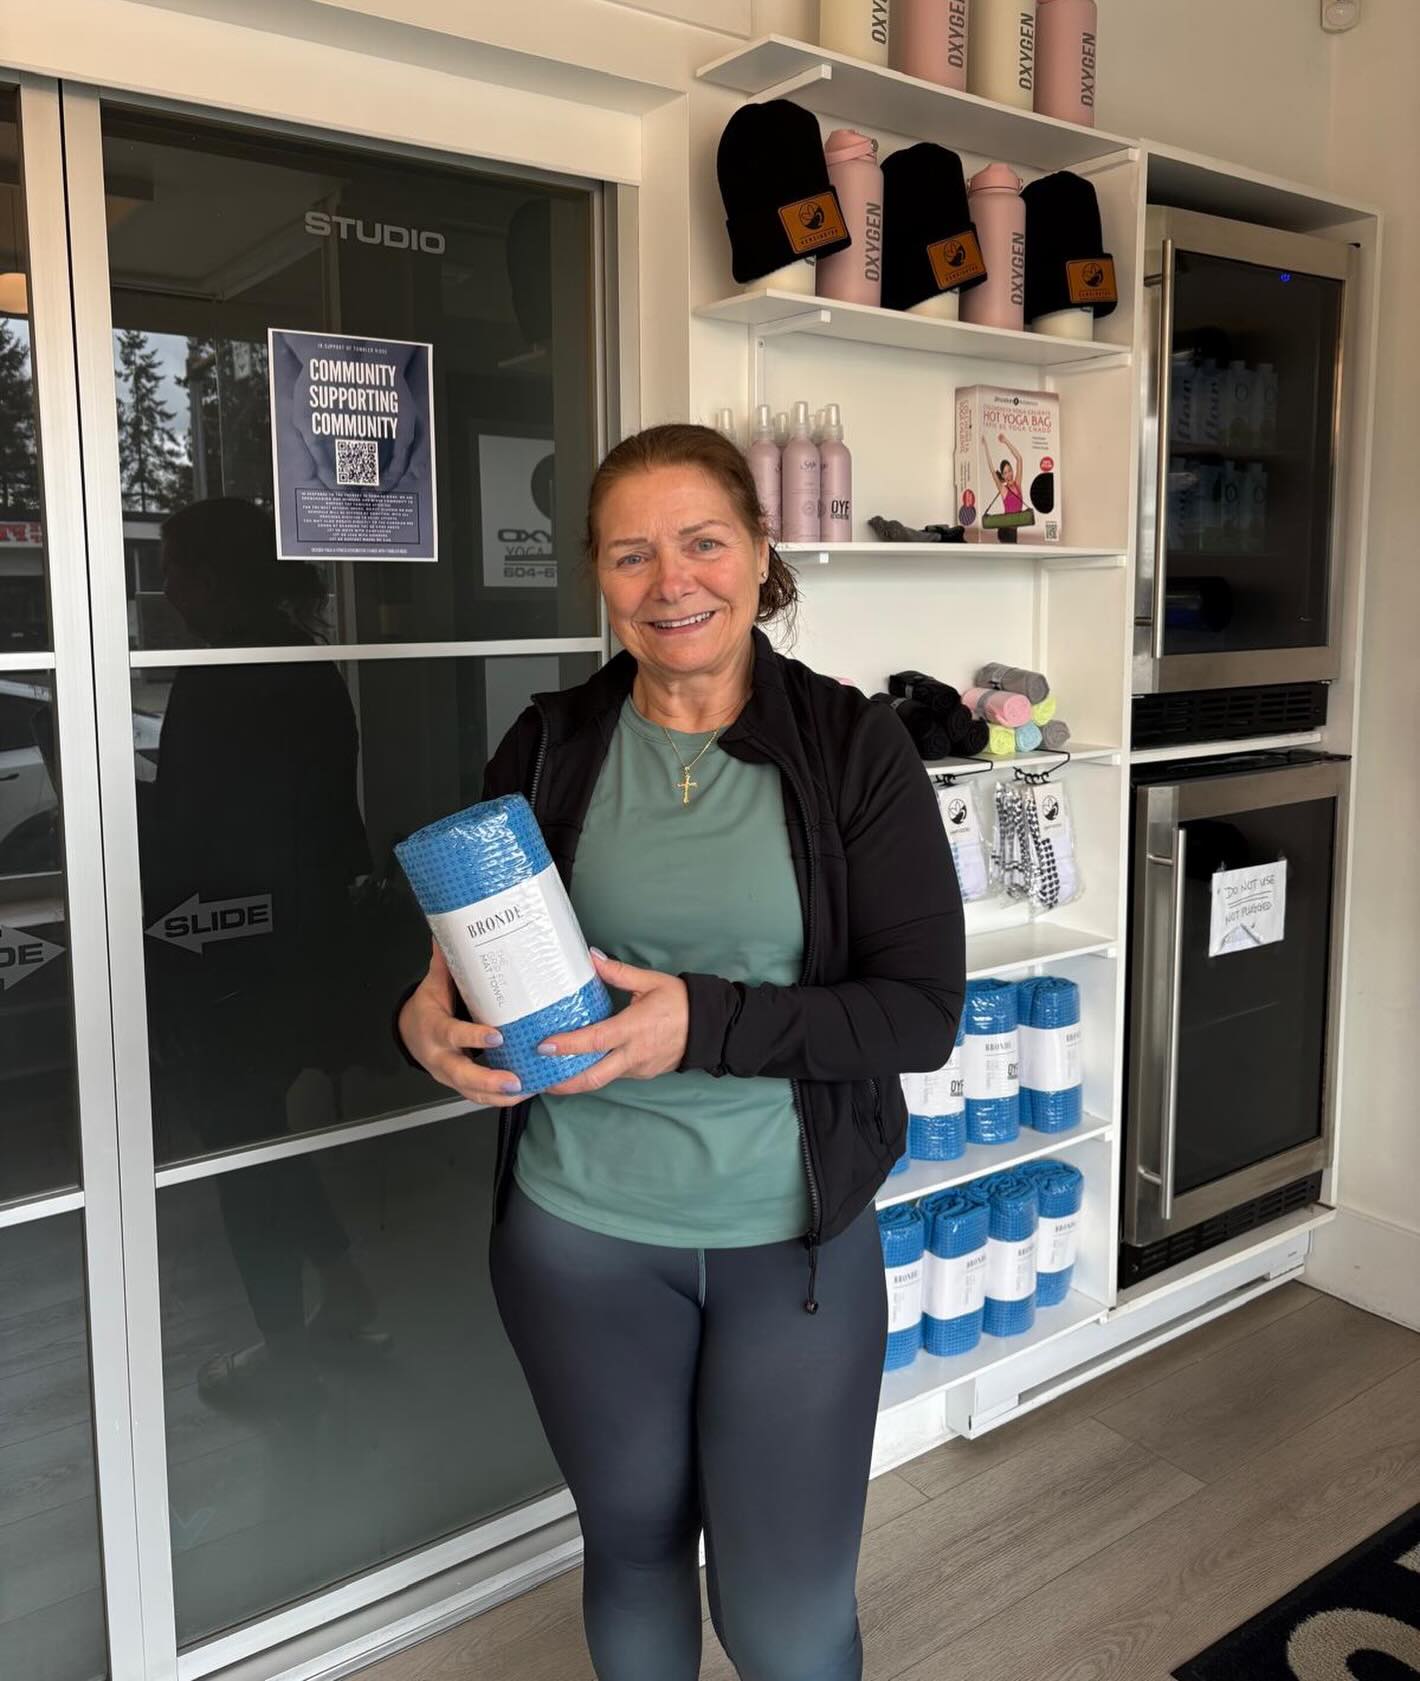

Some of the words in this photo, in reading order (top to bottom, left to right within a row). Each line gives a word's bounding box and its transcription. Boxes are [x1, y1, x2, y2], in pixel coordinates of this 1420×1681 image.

[872, 0, 887, 45] OXY
[948, 0, 965, 68] OXYGE
[1019, 12, 1034, 91] OXYGEN
[1080, 32, 1096, 108] OXYGEN
[304, 211, 446, 255] STUDIO
[865, 202, 881, 282] OXYGEN
[1011, 231, 1024, 306] OXYGEN
[309, 358, 396, 387] COMMUNITY
[309, 385, 399, 414] SUPPORTING
[312, 412, 398, 439] COMMUNITY
[983, 410, 1000, 424] HOT
[1003, 413, 1029, 426] YOGA
[1032, 415, 1052, 428] BAG
[1224, 886, 1239, 899] DO
[1240, 878, 1258, 891] NOT
[1260, 874, 1275, 886] USE
[164, 904, 270, 938] SLIDE
[466, 904, 524, 939] BRONDE
[488, 976, 506, 1008] TOWEL
